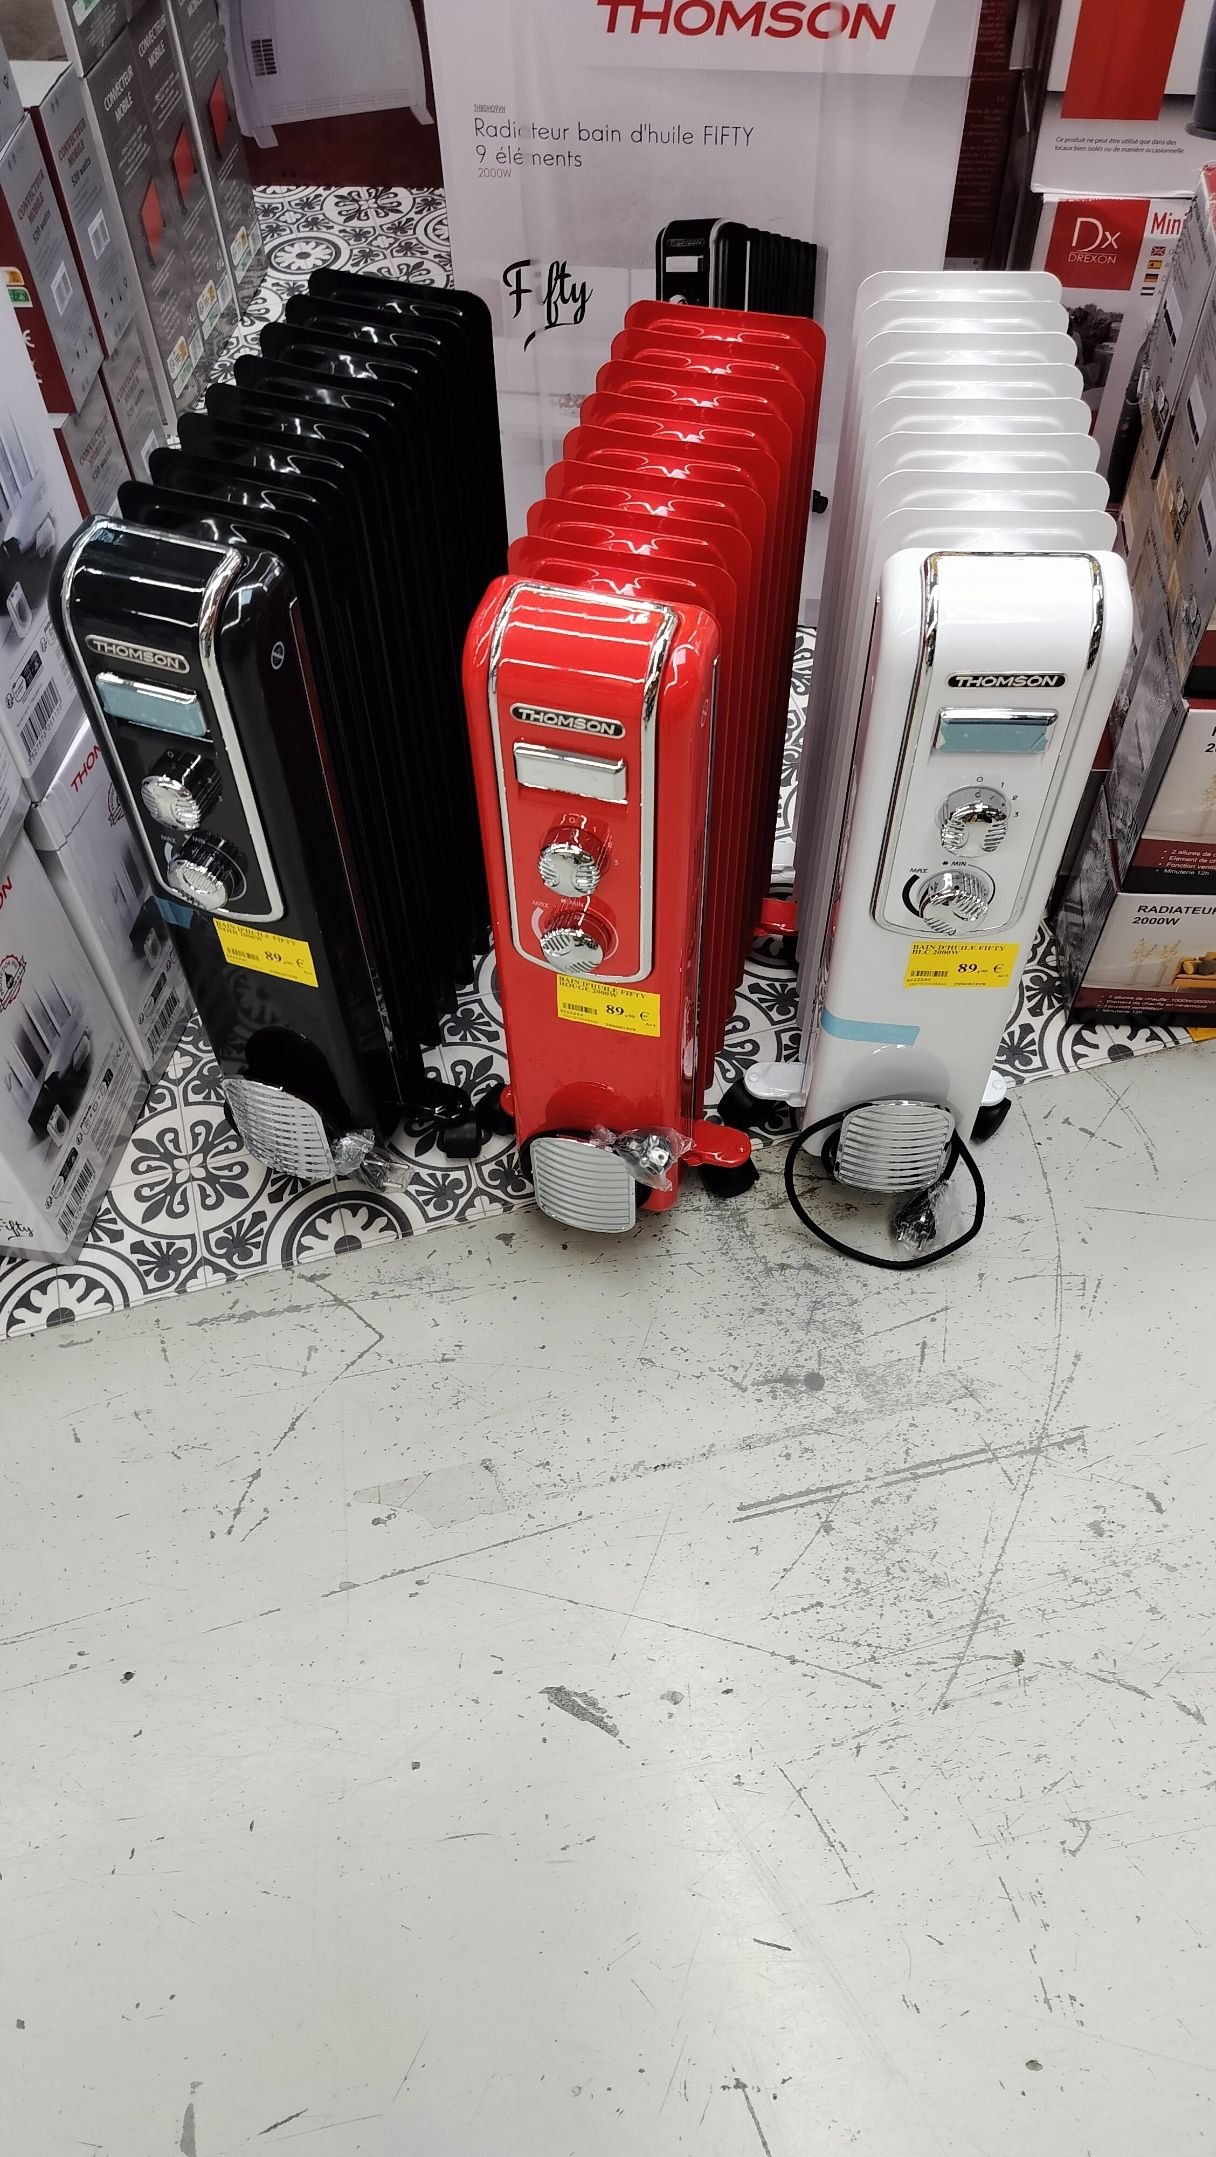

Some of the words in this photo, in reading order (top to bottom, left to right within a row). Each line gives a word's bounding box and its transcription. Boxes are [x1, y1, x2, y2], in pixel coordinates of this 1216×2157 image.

[598, 0, 896, 40] THOMSON
[578, 121, 621, 142] bain
[631, 123, 694, 145] d'huile
[703, 125, 754, 147] FIFTY
[475, 144, 486, 164] 9
[478, 168, 512, 179] 2000W
[1071, 217, 1121, 252] Dx
[1068, 253, 1117, 264] DREXON
[92, 640, 180, 669] THOMSON
[956, 675, 1059, 687] THOMSON
[518, 708, 616, 735] THOMSON
[1132, 916, 1180, 925] 2000W
[560, 976, 580, 985] BAIN
[582, 980, 617, 993] D'HUILE
[621, 989, 647, 999] FIFTY
